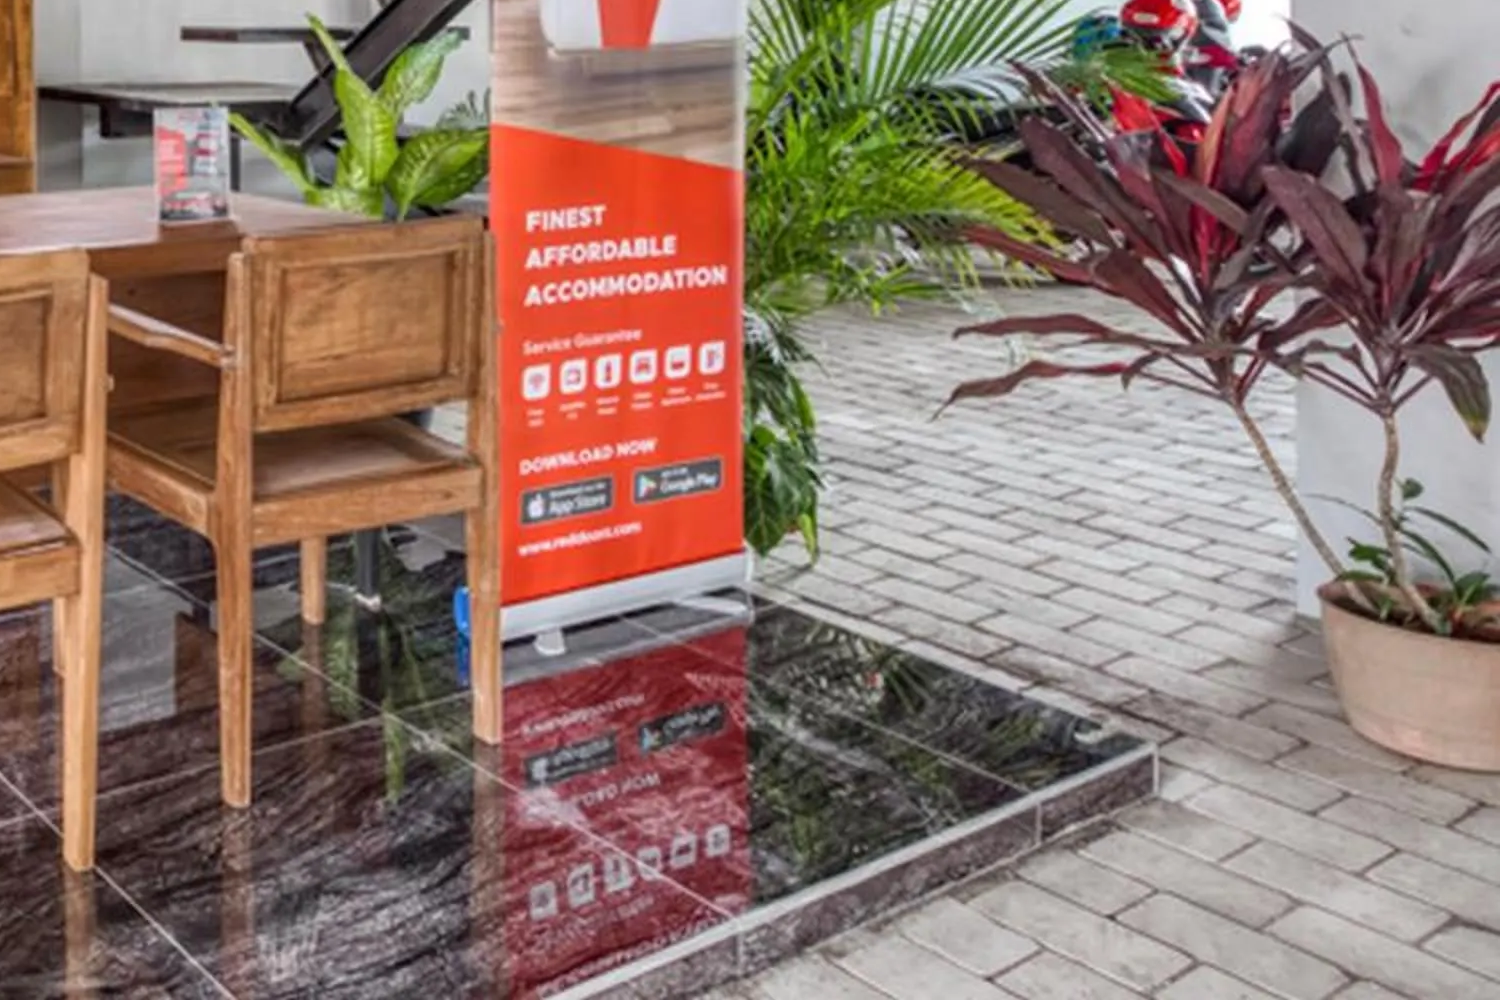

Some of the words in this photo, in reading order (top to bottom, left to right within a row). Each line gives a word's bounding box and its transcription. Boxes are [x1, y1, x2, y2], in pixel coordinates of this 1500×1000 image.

[525, 205, 607, 233] FINEST
[524, 235, 678, 270] AFFORDABLE
[523, 265, 728, 308] ACCOMMODATION
[523, 338, 572, 356] Service
[519, 443, 614, 475] DOWNLOAD
[616, 438, 658, 457] NOW
